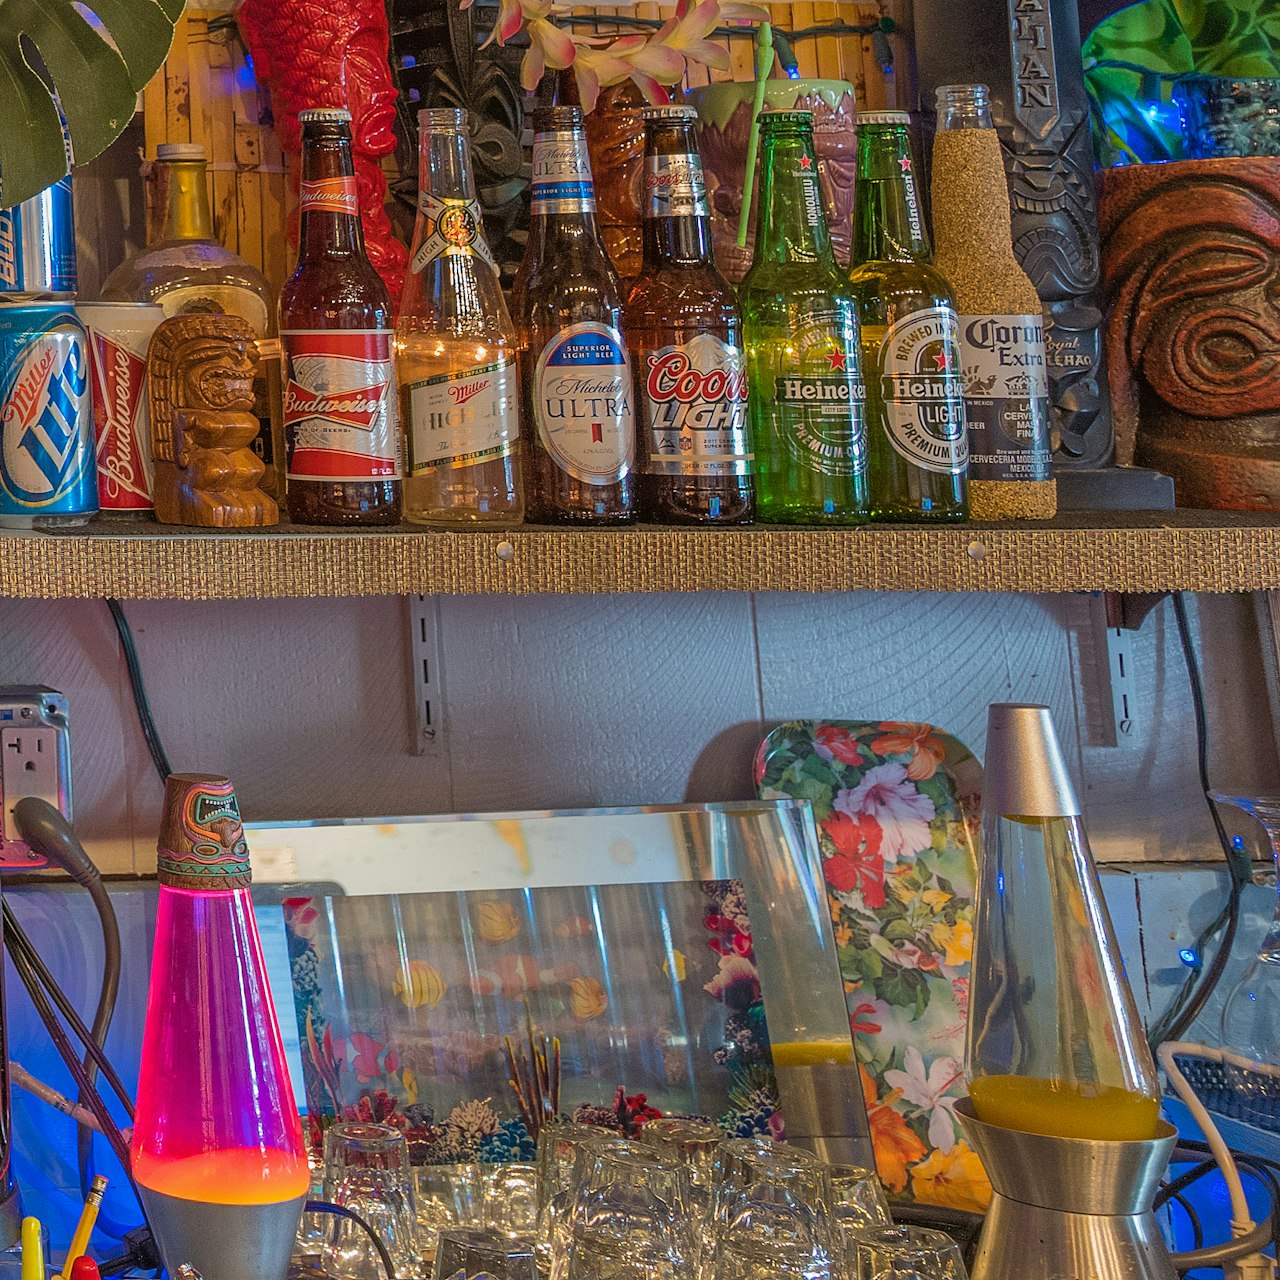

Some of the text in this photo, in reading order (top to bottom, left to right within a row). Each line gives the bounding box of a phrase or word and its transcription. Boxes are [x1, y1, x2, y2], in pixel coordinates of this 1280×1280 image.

[301, 188, 356, 203] Budweiser
[803, 179, 818, 227] HONOLULU
[905, 175, 922, 240] Heineken
[565, 344, 611, 352] SUPERIOR
[965, 318, 1044, 353] Coron
[562, 351, 591, 360] LIGHT
[1, 346, 57, 430] Miller
[647, 351, 749, 403] Coors
[283, 389, 388, 415] Budweiser
[448, 379, 490, 405] Miller
[17, 340, 87, 499] Lite
[106, 332, 130, 499] Budweiser
[545, 397, 632, 419] ULTRA
[652, 402, 748, 431] LIGHT
[926, 406, 964, 424] LIGHT
